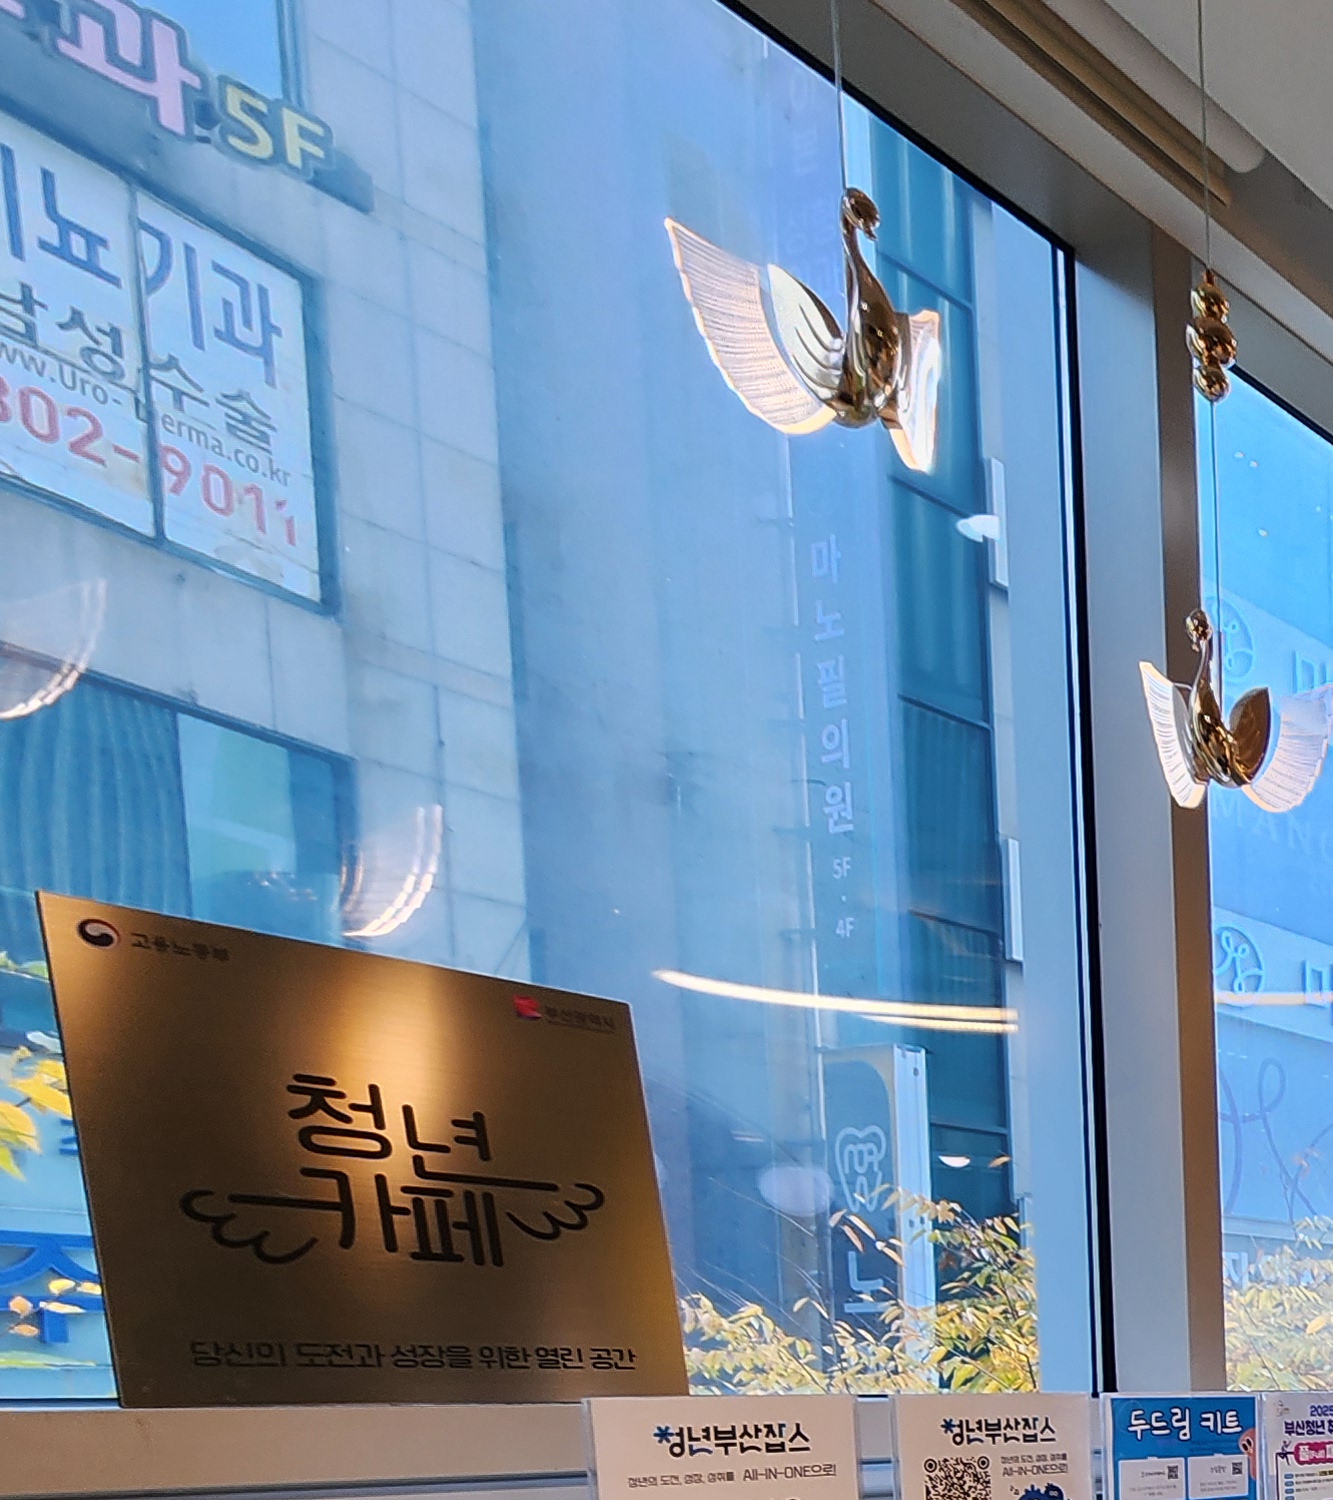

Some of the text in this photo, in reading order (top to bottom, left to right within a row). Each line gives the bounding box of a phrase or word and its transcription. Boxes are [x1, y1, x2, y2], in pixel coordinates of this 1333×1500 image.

[225, 84, 326, 169] 5F
[832, 857, 852, 880] 5F
[835, 917, 855, 939] 4F
[287, 1072, 559, 1192] 청년
[230, 1166, 504, 1267] 카페
[189, 1339, 637, 1371] 당신의 도전과 성장을 위한 열린 공간
[652, 1422, 811, 1458] 청년부산잡스
[1127, 1407, 1243, 1441] 두드림 키트
[1284, 1419, 1326, 1436] 부산청년
